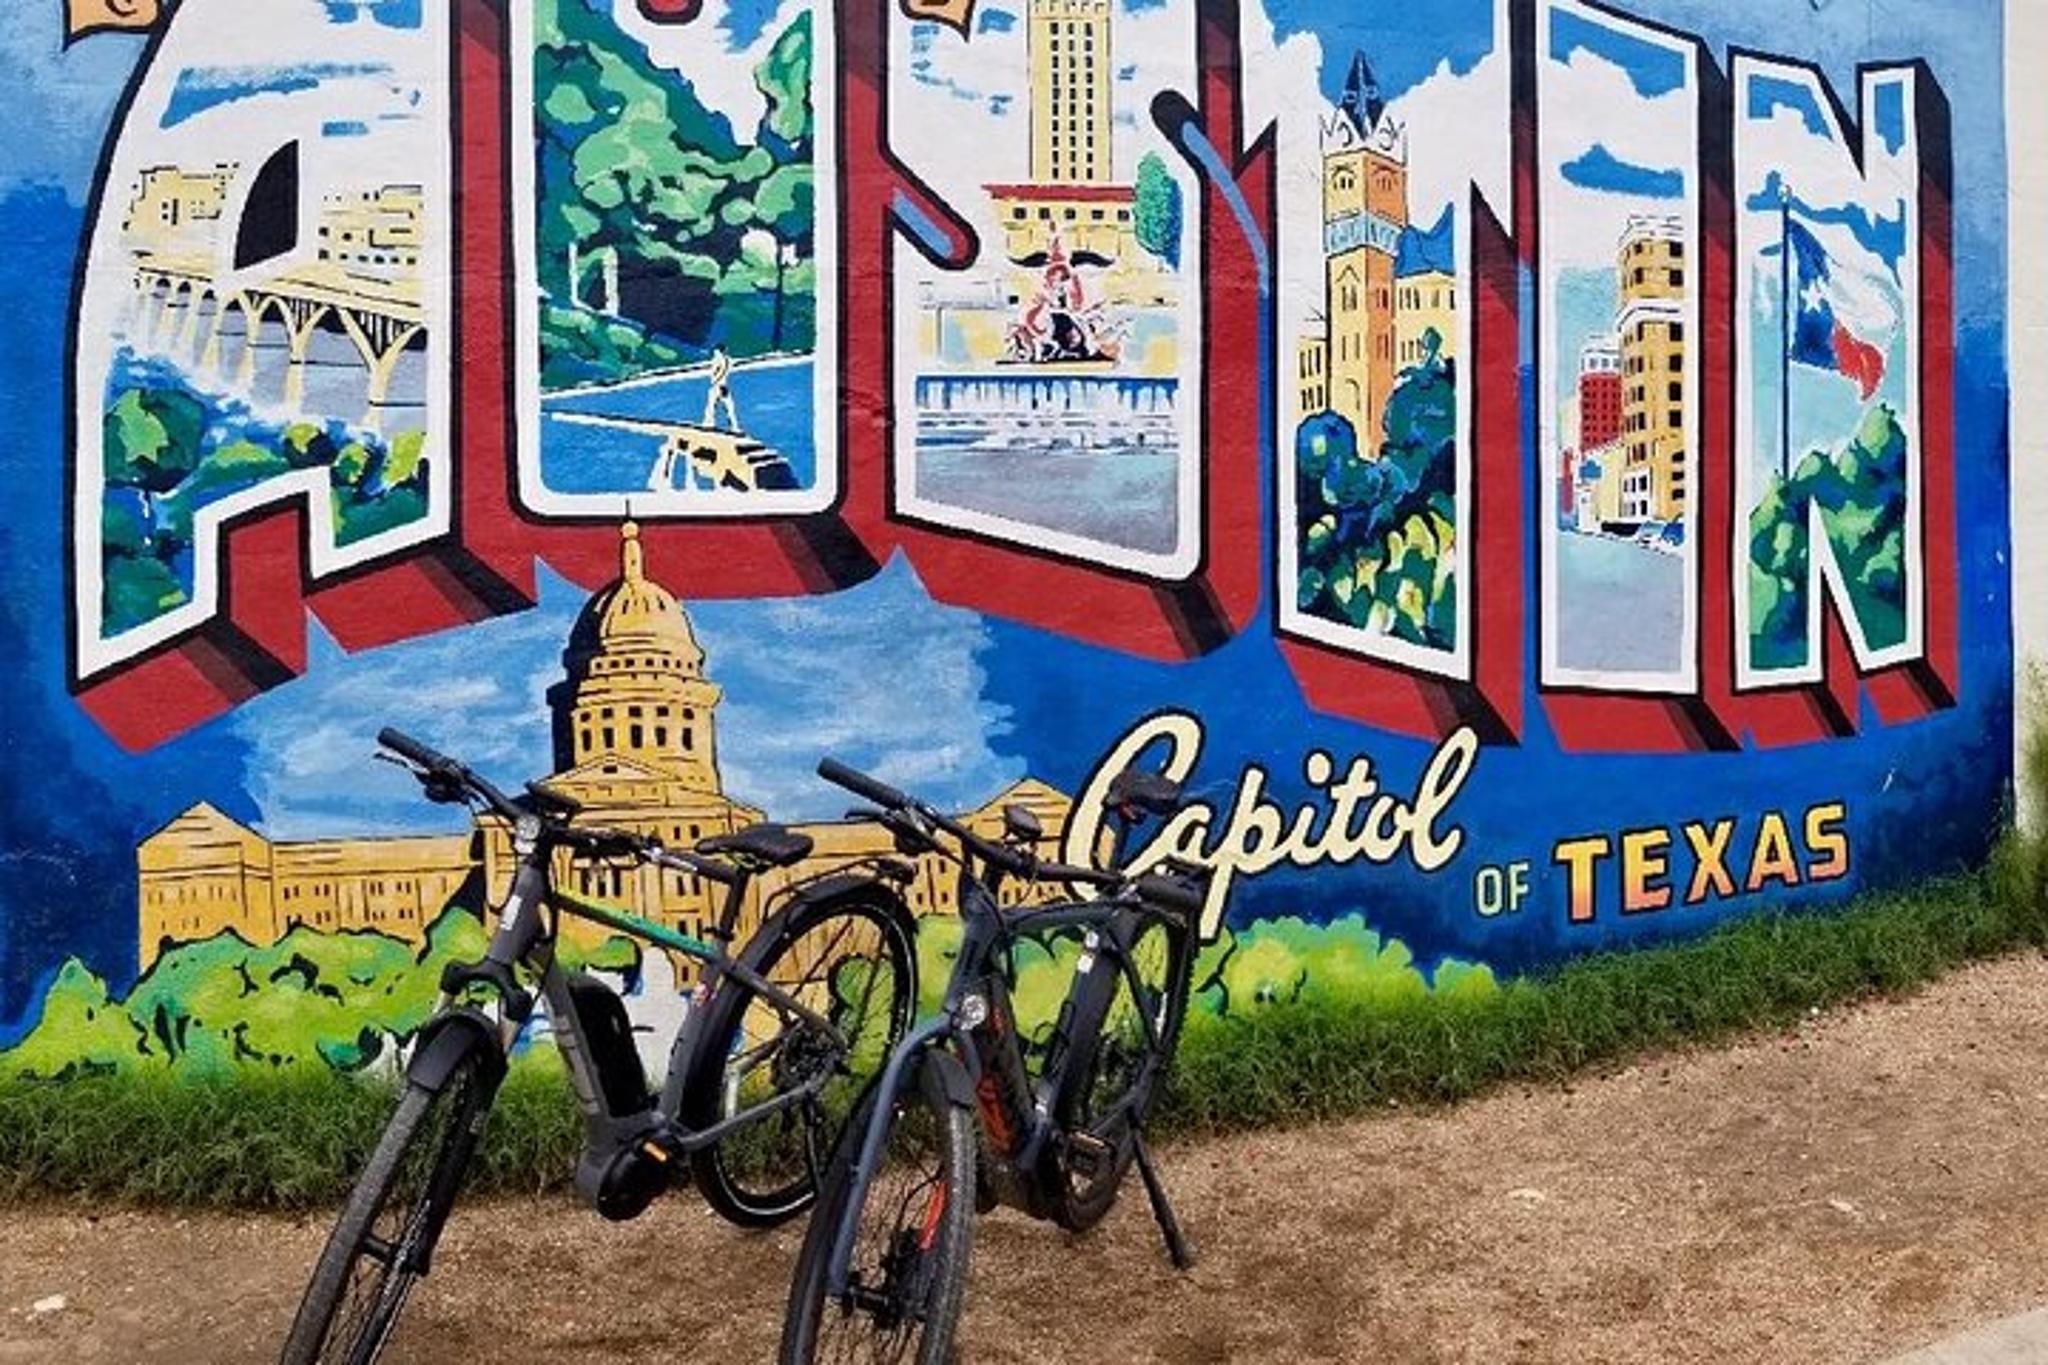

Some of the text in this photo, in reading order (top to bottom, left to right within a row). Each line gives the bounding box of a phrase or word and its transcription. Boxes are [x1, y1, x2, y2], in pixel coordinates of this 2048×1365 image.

[70, 0, 1940, 705] AUSTIN
[1062, 710, 1851, 941] Capitol OF TEXAS
